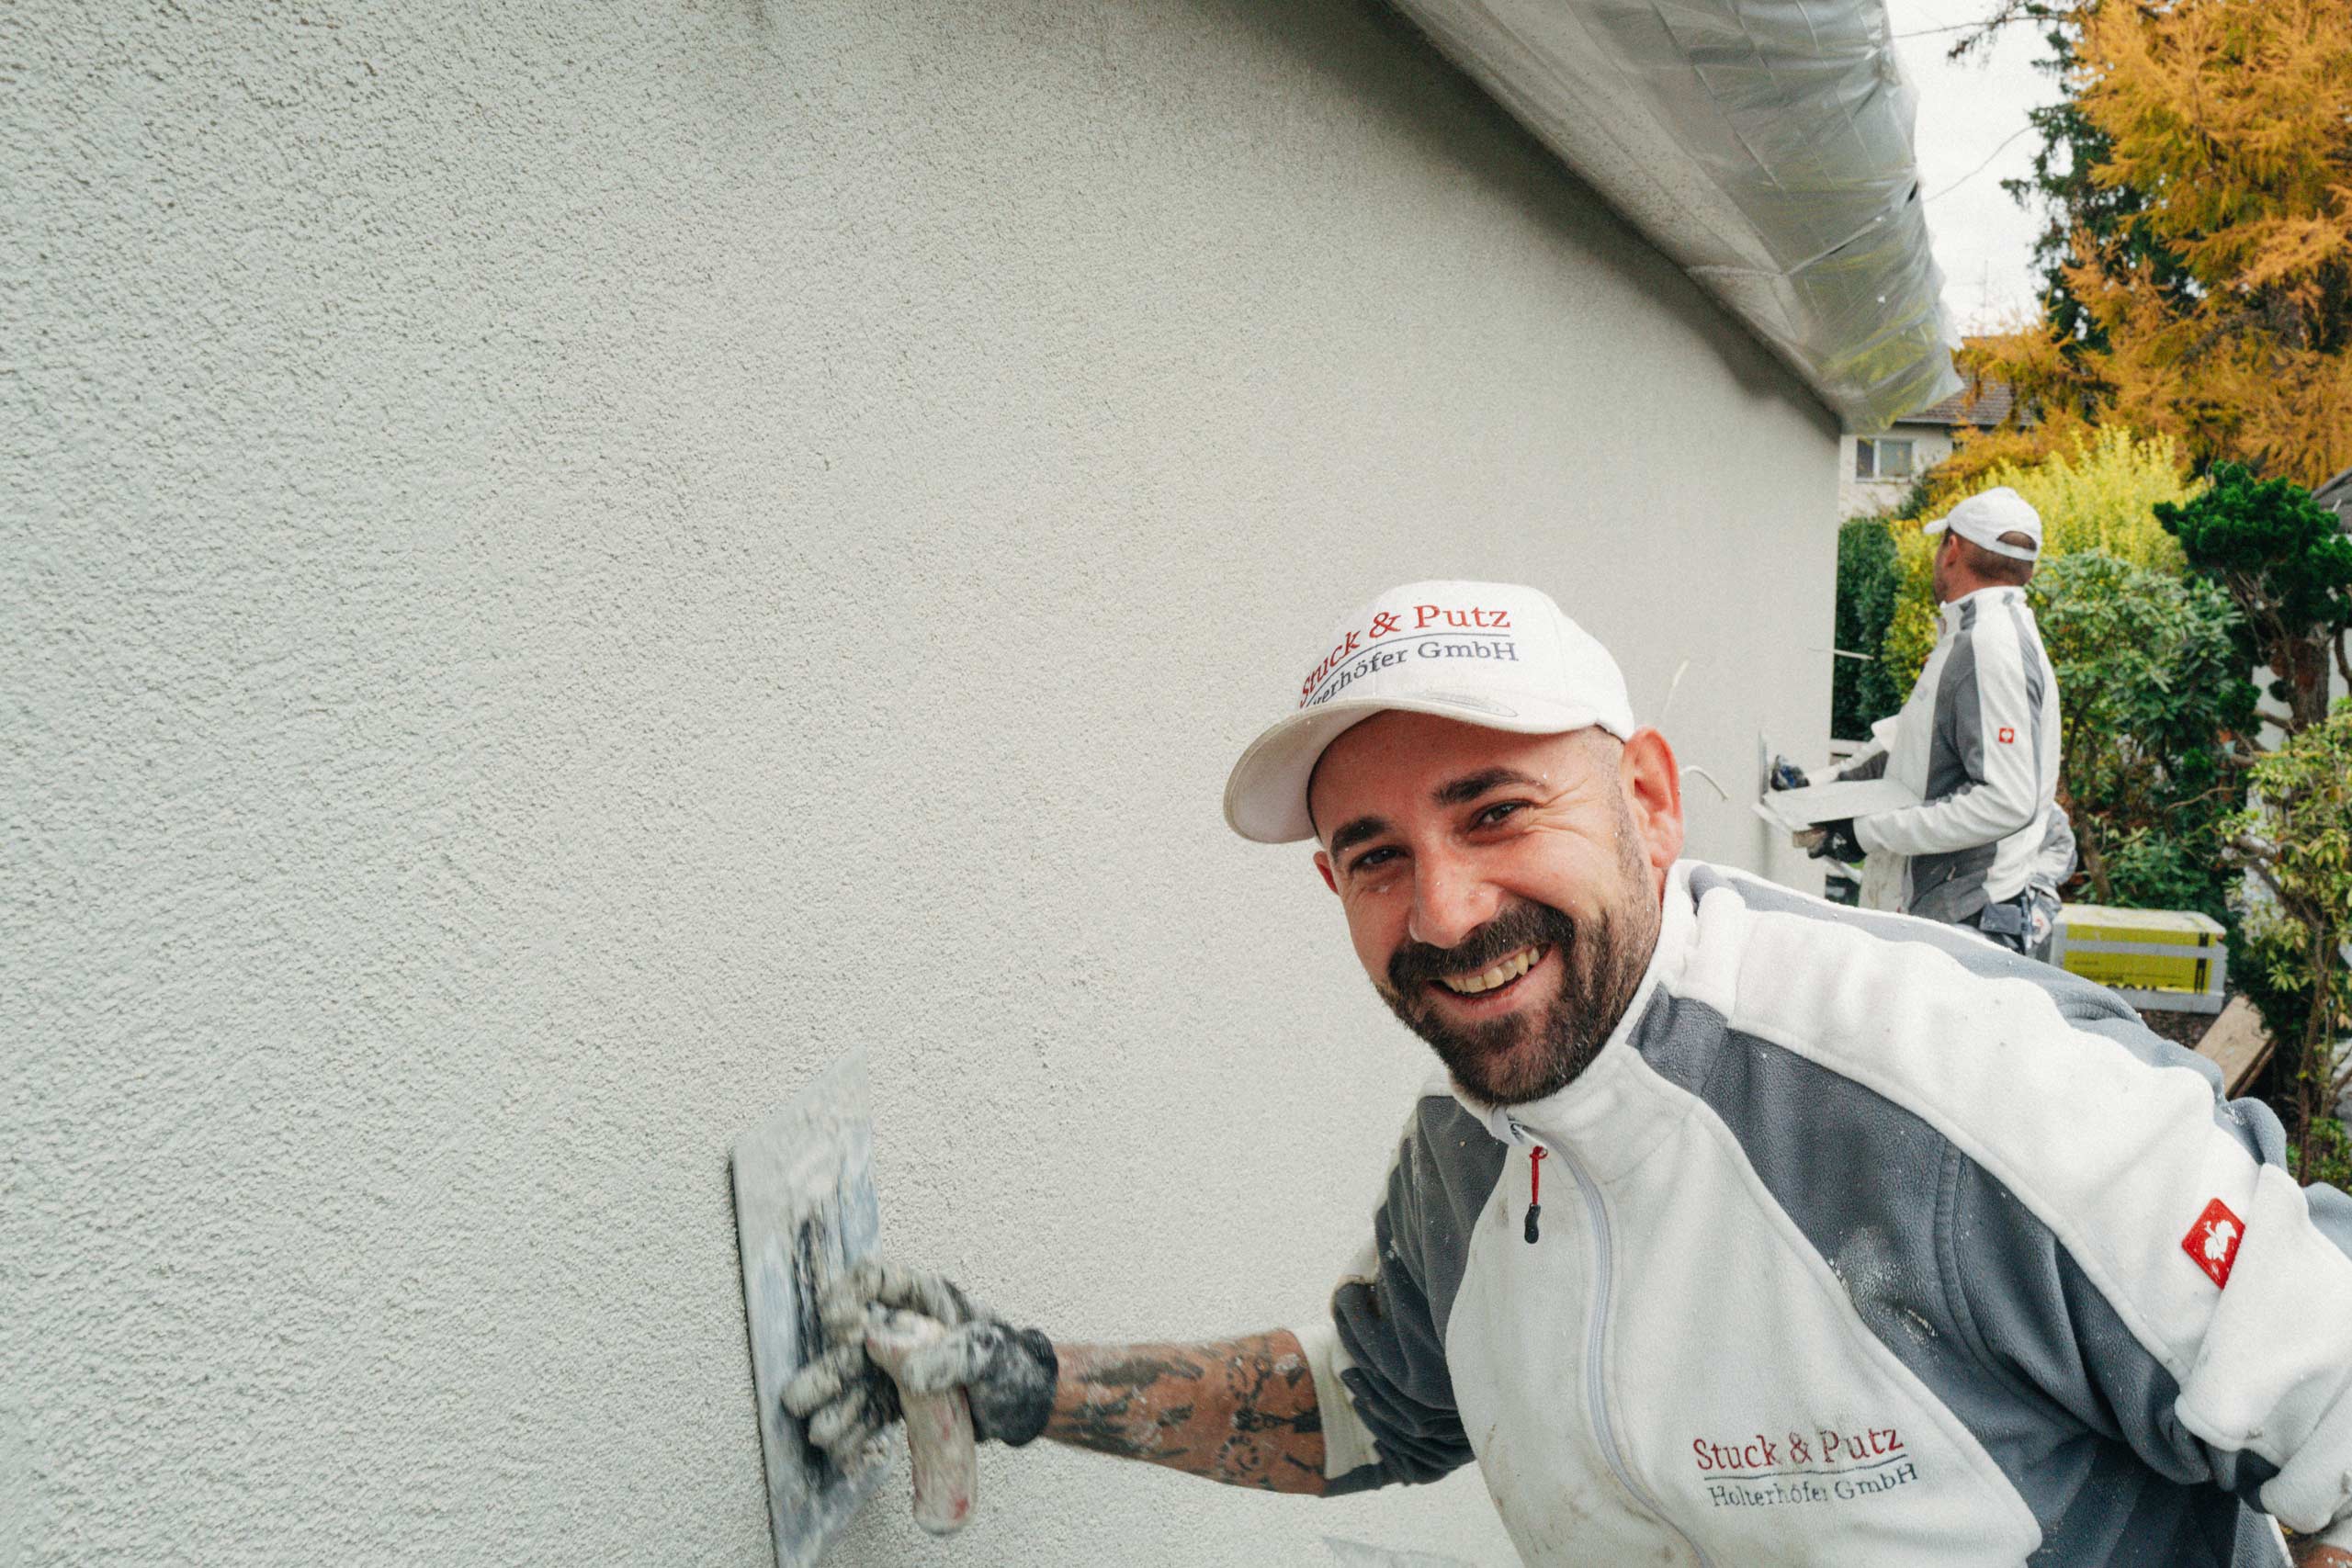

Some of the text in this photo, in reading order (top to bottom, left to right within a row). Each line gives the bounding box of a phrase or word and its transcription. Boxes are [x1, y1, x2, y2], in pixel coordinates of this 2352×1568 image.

[1299, 604, 1511, 708] Stuck & Putz
[1418, 641, 1519, 661] GmbH
[1693, 1427, 1905, 1470] Stuck & Putz
[1707, 1462, 1918, 1506] Holterhöfer GmbH
